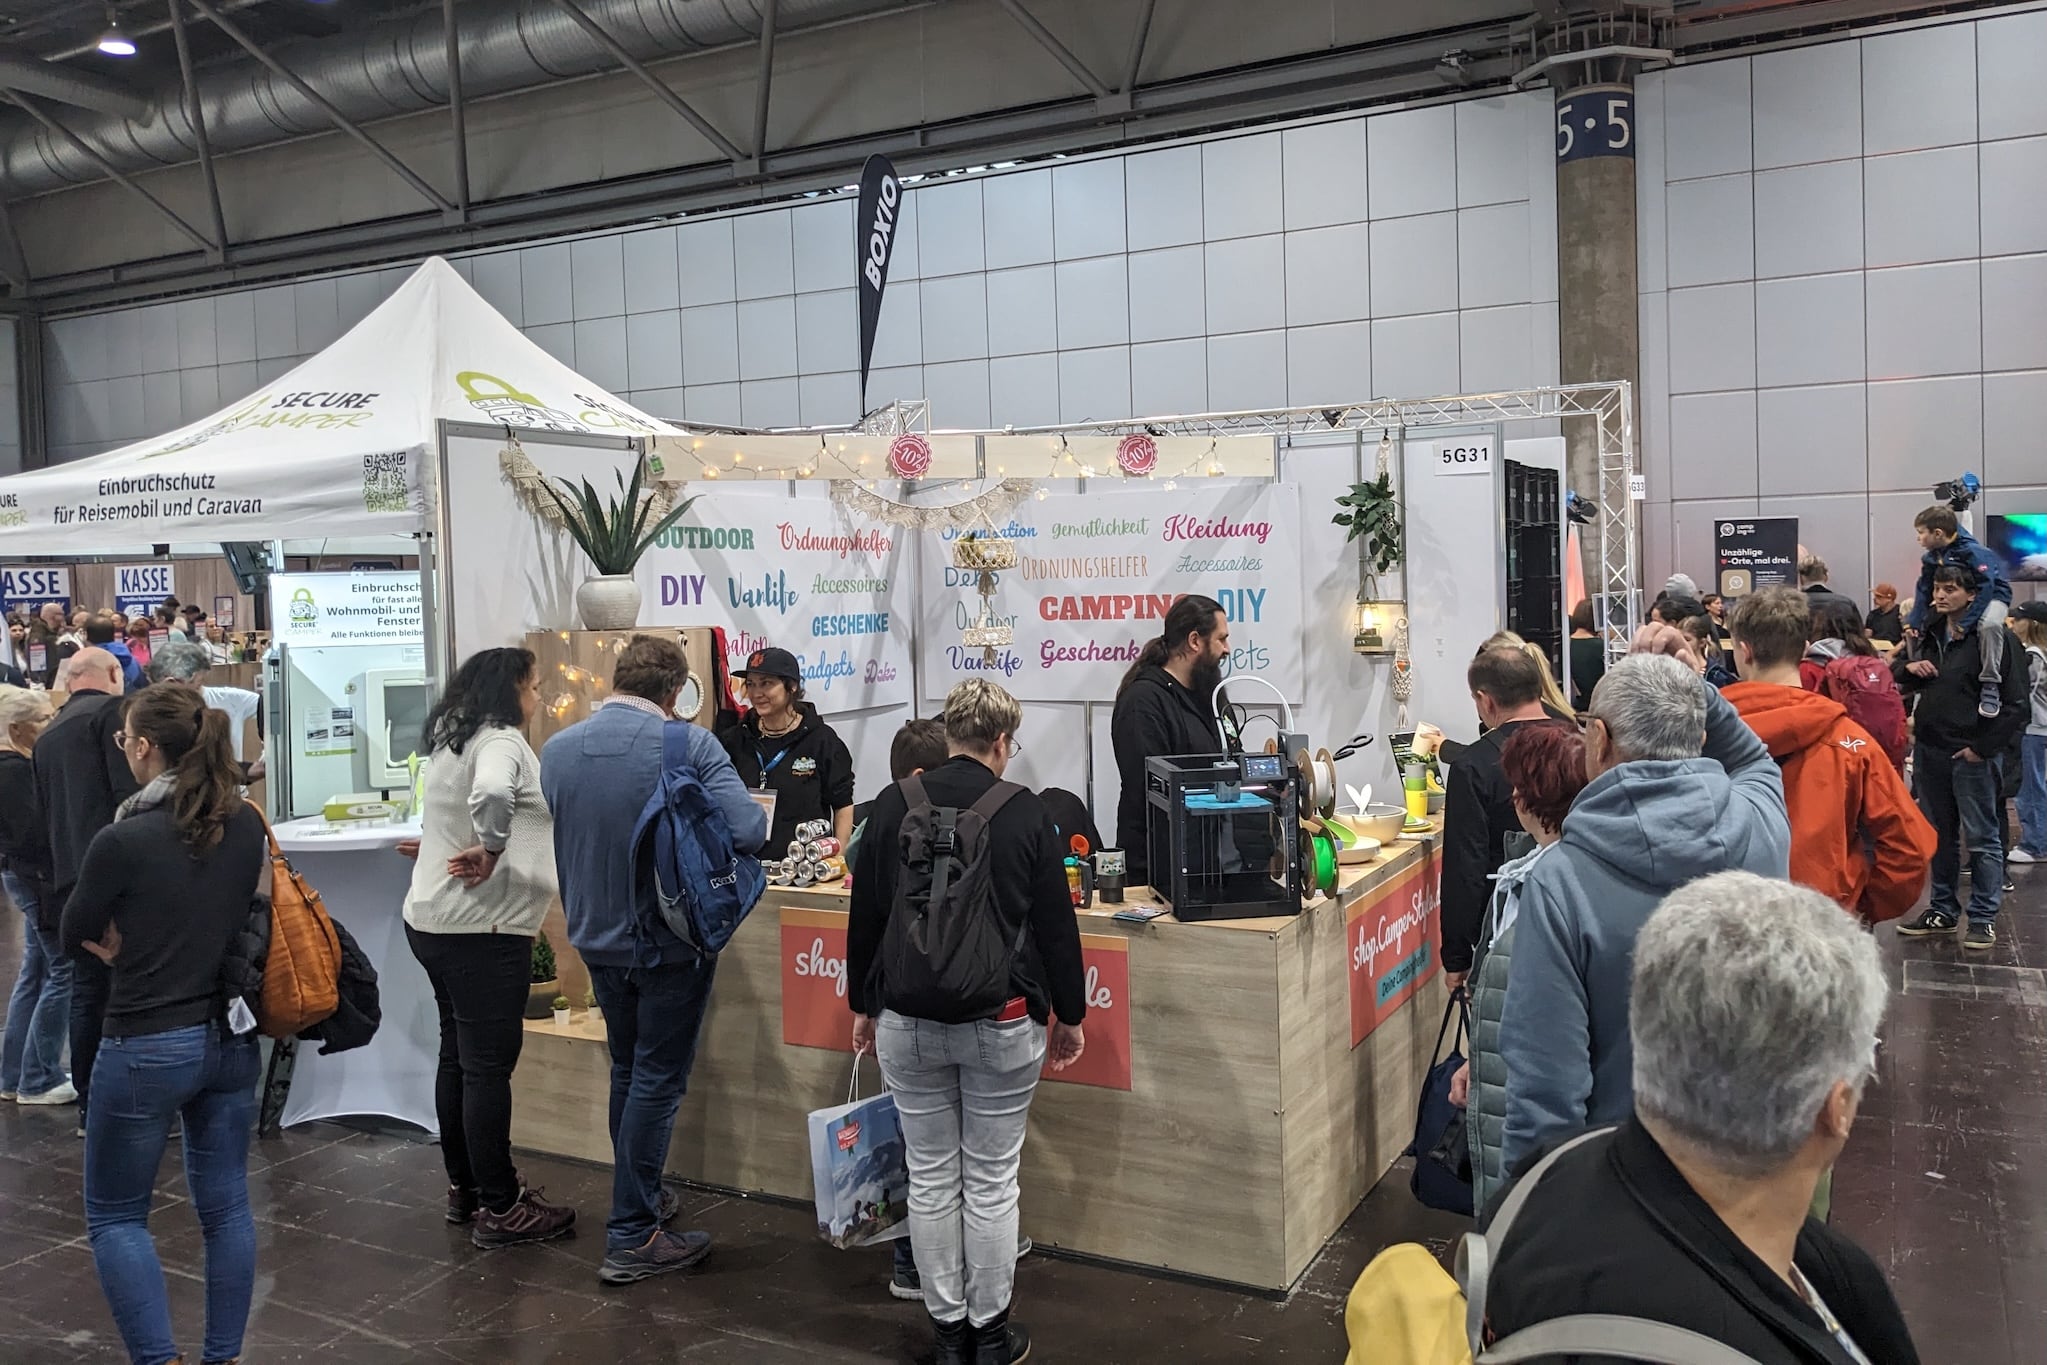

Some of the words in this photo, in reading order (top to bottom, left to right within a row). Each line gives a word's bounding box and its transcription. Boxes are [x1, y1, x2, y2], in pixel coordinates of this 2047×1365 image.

[865, 174, 897, 292] BOXIO
[272, 391, 380, 409] SECURE
[226, 411, 374, 434] CAMPER
[1442, 447, 1488, 464] 5G31
[99, 472, 216, 496] Einbruchschutz
[1631, 481, 1645, 492] G33
[0, 493, 18, 508] URE
[54, 505, 75, 524] für
[78, 498, 158, 522] Reisemobil
[164, 500, 192, 517] und
[197, 497, 262, 516] Caravan
[655, 526, 755, 550] OUTDOOR
[776, 521, 894, 560] Ordnungshelfer
[1163, 514, 1273, 544] Kleidung
[1022, 554, 1149, 582] ORDNUNGSHELFER
[1176, 554, 1264, 573] Accessoires
[1755, 557, 1771, 565] mal
[1772, 556, 1791, 564] drei.
[4, 570, 61, 595] ASSE
[121, 567, 168, 592] KASSE
[352, 582, 421, 593] Einbruchsch
[661, 574, 706, 606] DIY
[812, 573, 889, 594] Accessoires
[372, 596, 385, 604] für
[387, 596, 405, 604] fast
[728, 569, 799, 615] Vanlife
[326, 605, 396, 616] Wohnmobil-
[399, 605, 421, 615] und
[1039, 594, 1185, 621] CAMPIN
[1218, 588, 1267, 622] DIY
[331, 630, 347, 639] Alle
[349, 630, 396, 639] Funktionen
[399, 628, 424, 637] bleibe
[378, 617, 421, 626] Fenster
[812, 612, 889, 637] GESCHENKE
[724, 630, 771, 657] sation
[1040, 639, 1141, 671] Geschenk
[1084, 965, 1113, 1009] le
